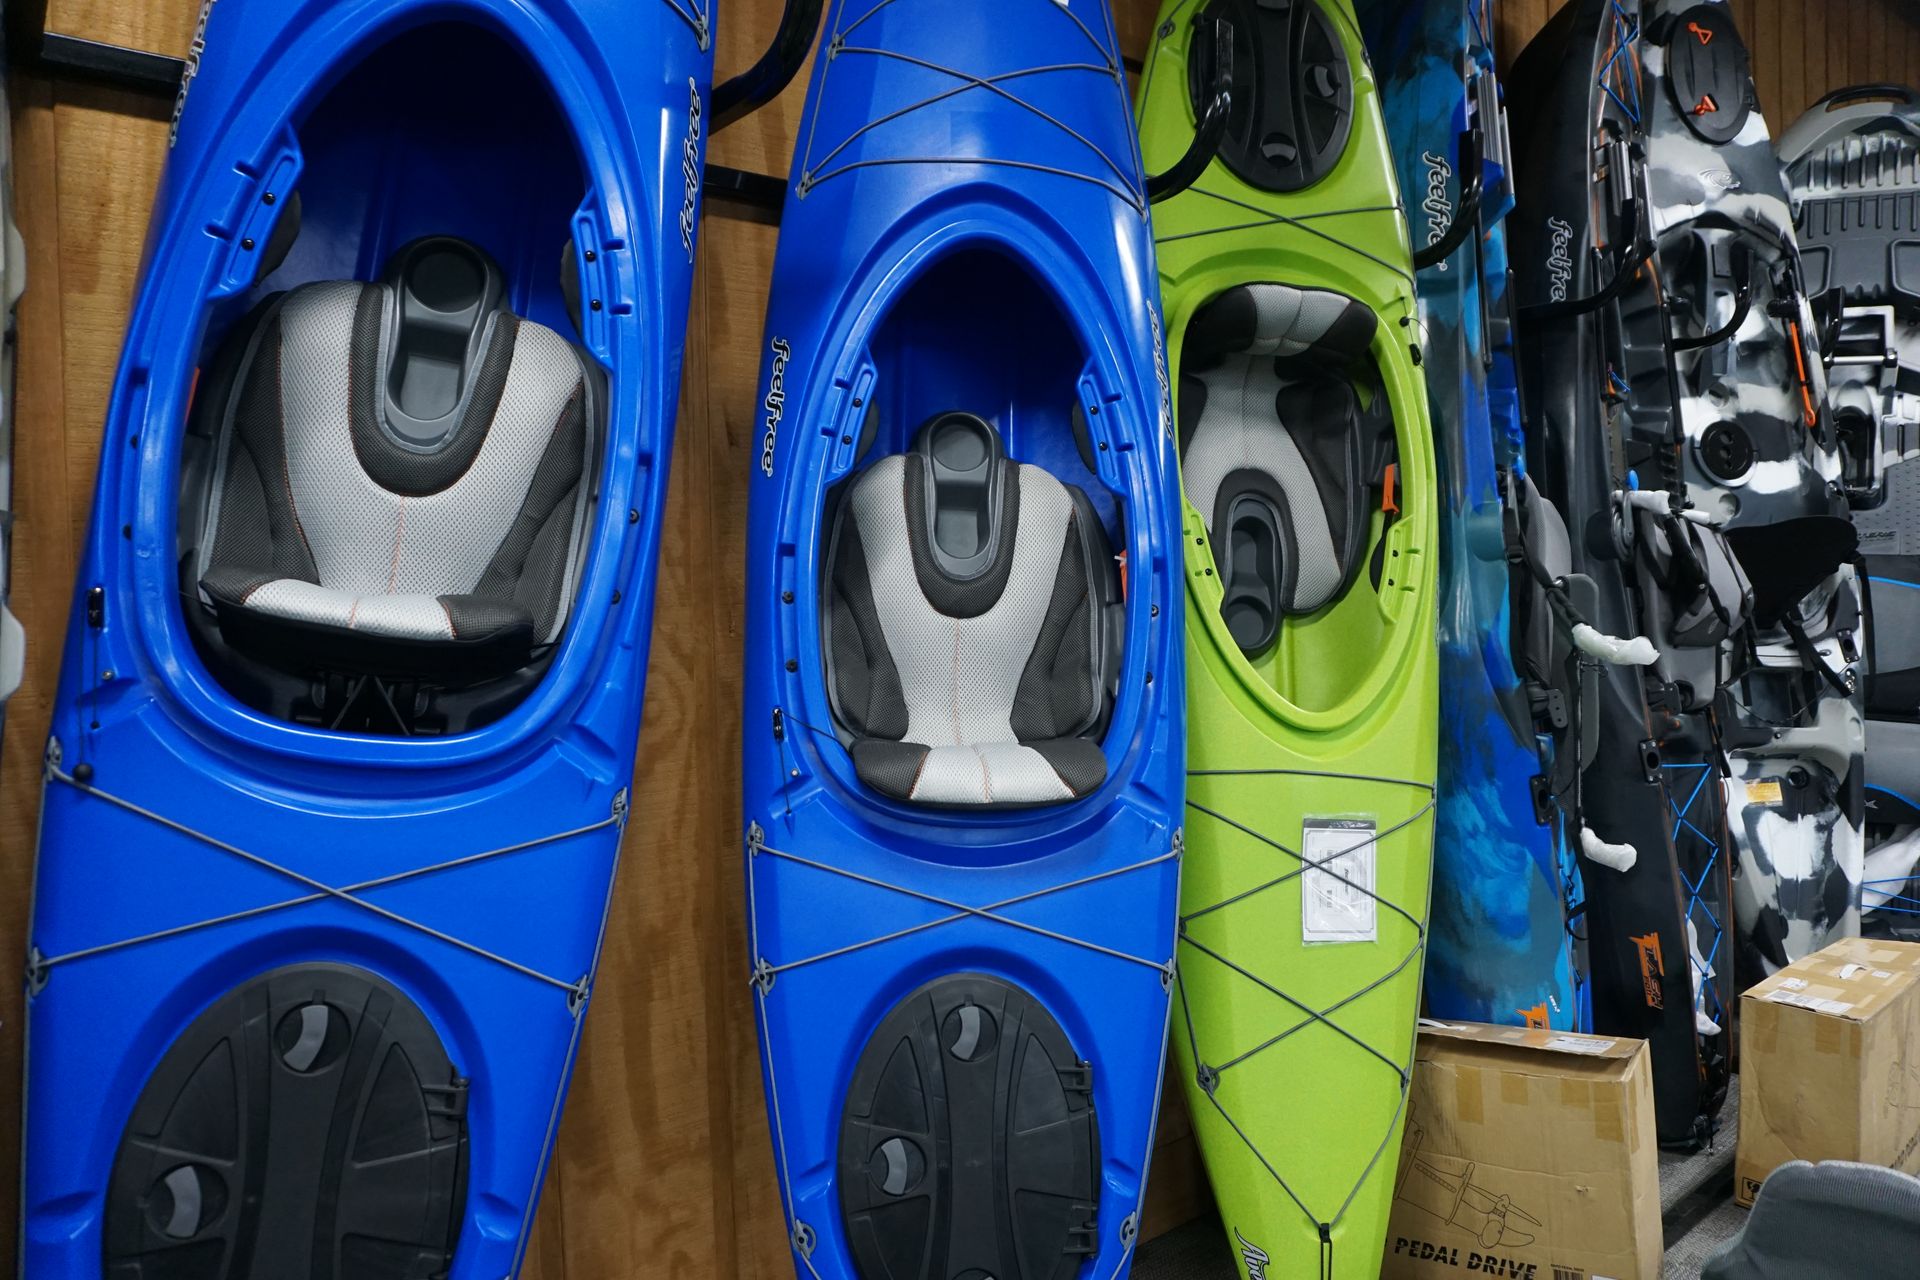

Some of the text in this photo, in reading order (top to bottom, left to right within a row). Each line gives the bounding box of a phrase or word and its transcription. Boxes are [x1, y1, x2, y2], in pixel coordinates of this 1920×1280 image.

[680, 77, 702, 264] feelfree
[1546, 216, 1574, 303] feelfre
[761, 336, 791, 478] feelfree
[1394, 1237, 1538, 1280] PEDAL DRIVE
